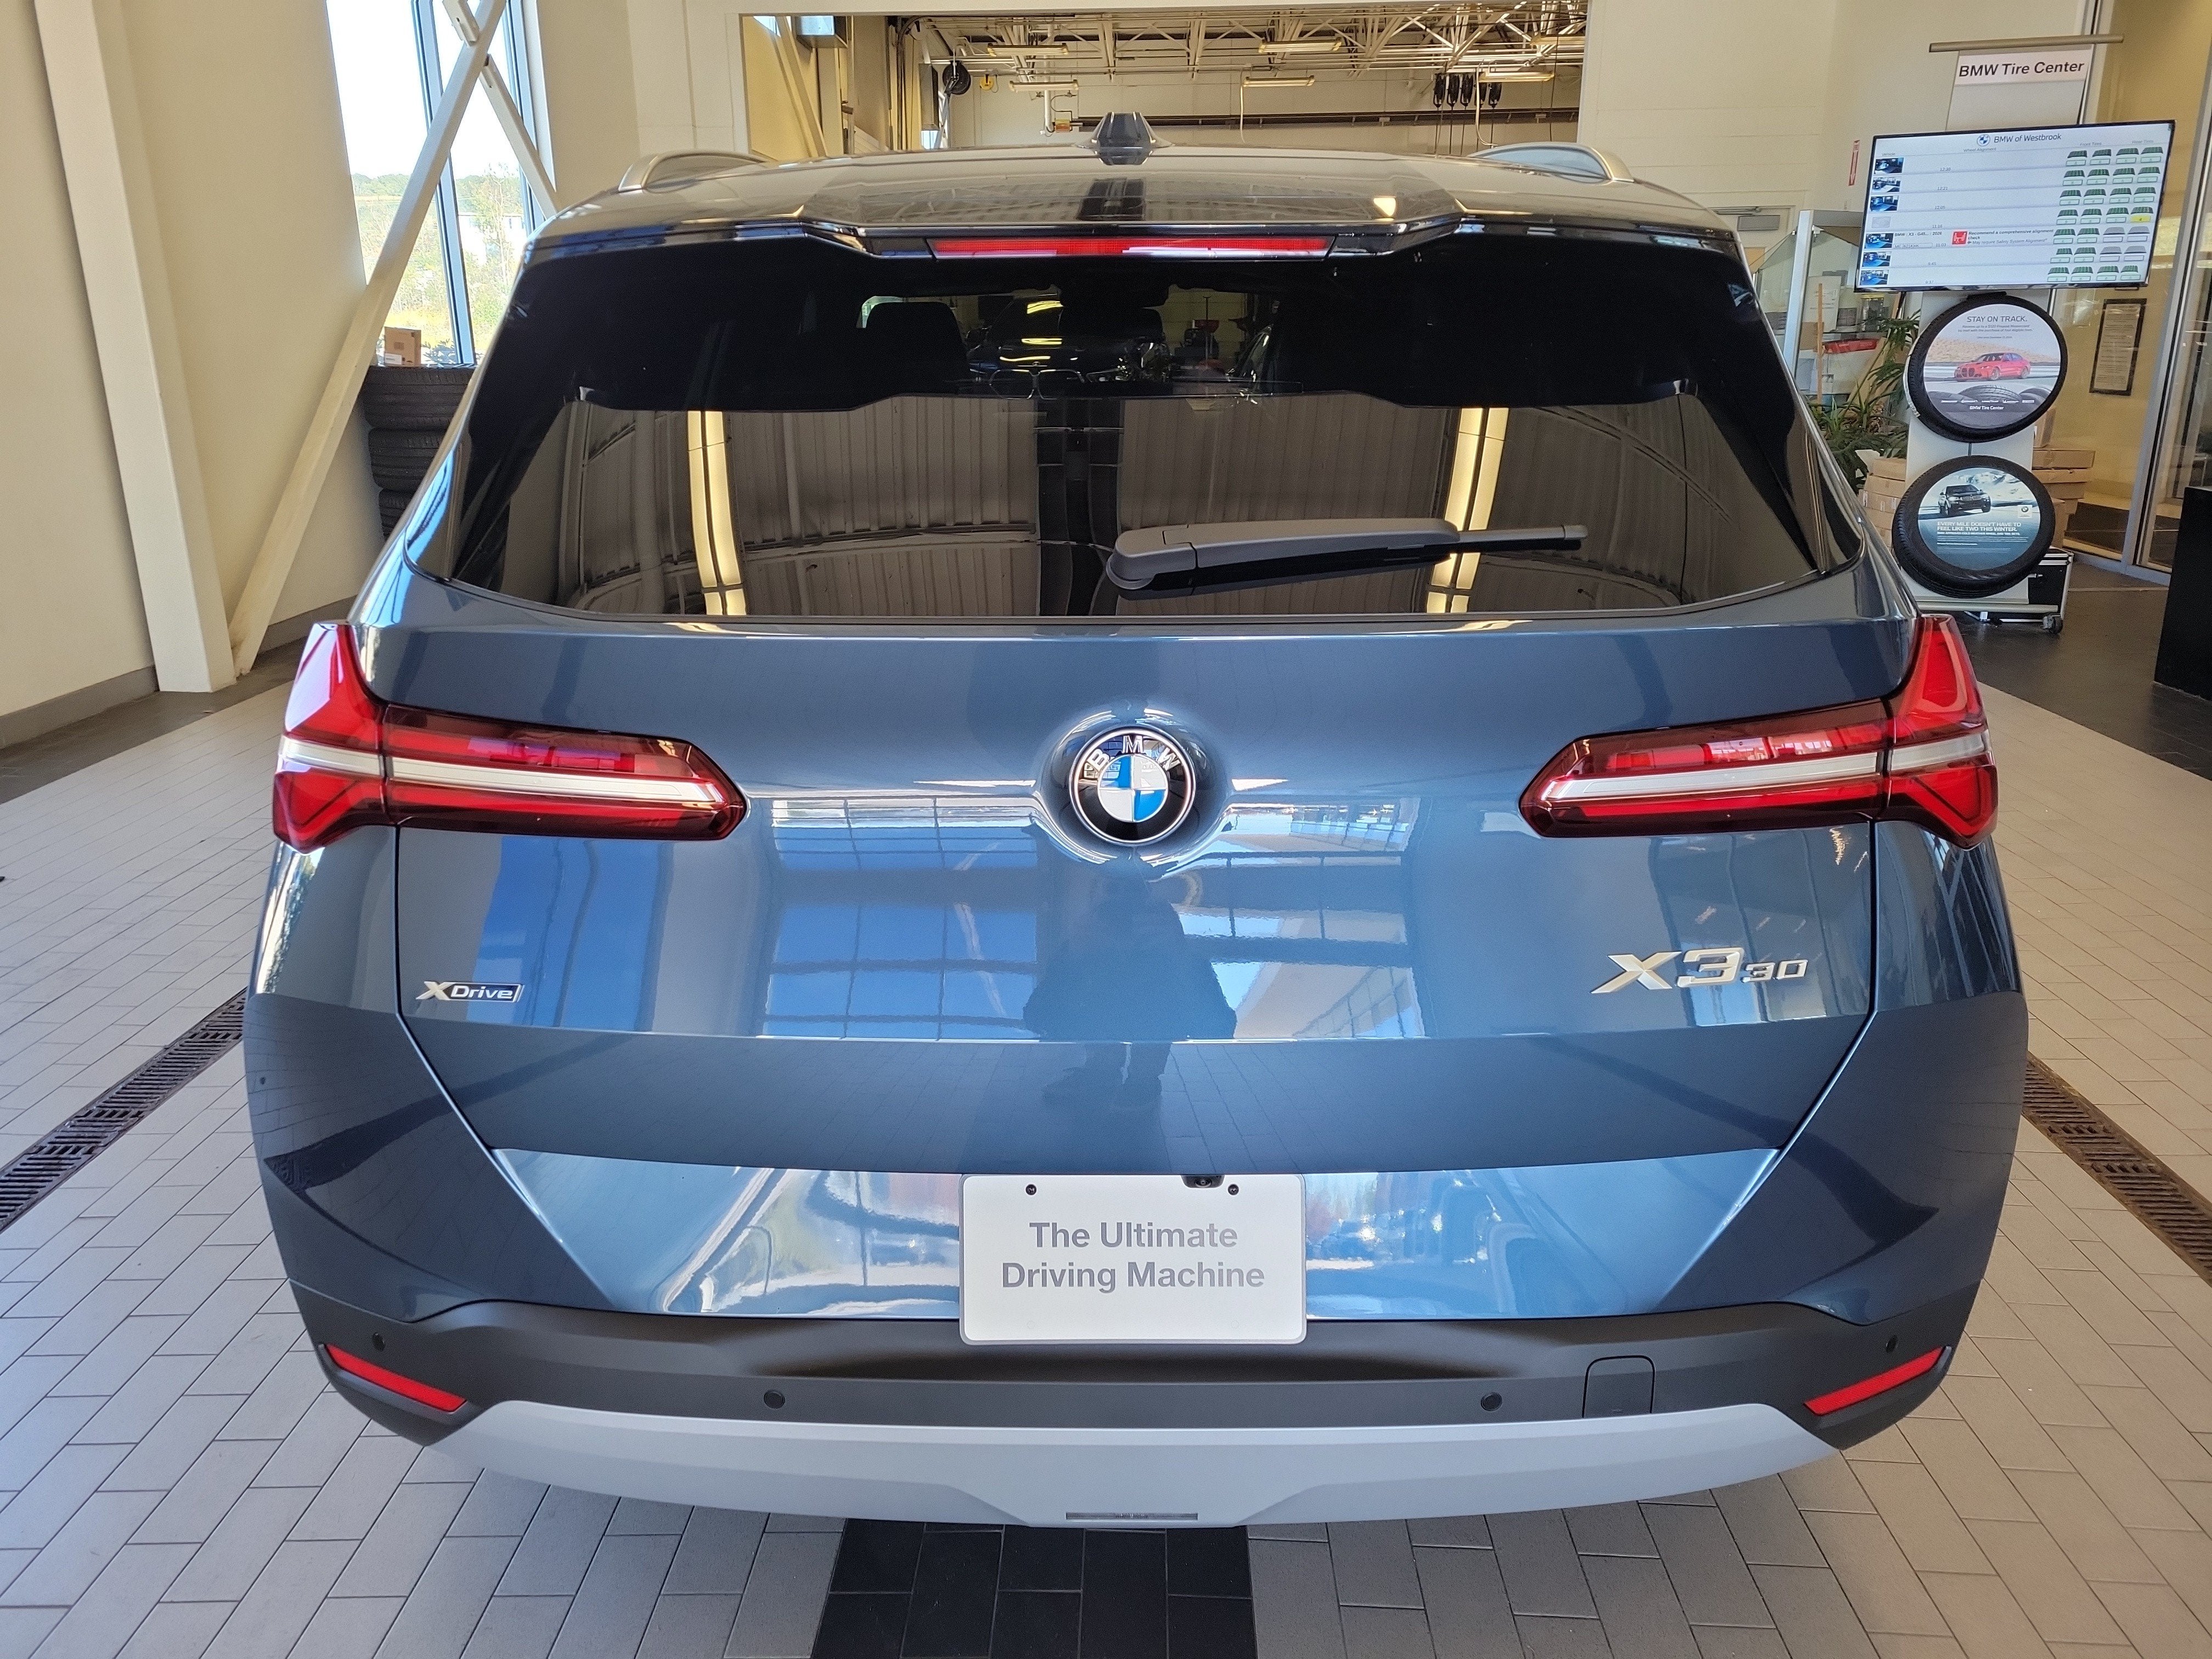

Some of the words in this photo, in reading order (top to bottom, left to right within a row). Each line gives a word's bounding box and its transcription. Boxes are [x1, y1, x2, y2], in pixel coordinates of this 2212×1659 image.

[1959, 64, 1999, 77] BMW
[2001, 63, 2030, 75] Tire
[2034, 61, 2085, 74] Center
[2024, 133, 2062, 142] Westbrook
[1087, 735, 1181, 771] BMW
[1590, 946, 1744, 994] X3
[1029, 1222, 1090, 1248] The
[1100, 1221, 1239, 1248] Ultimate
[1002, 1261, 1116, 1294] Driving
[1127, 1261, 1265, 1288] Machine
